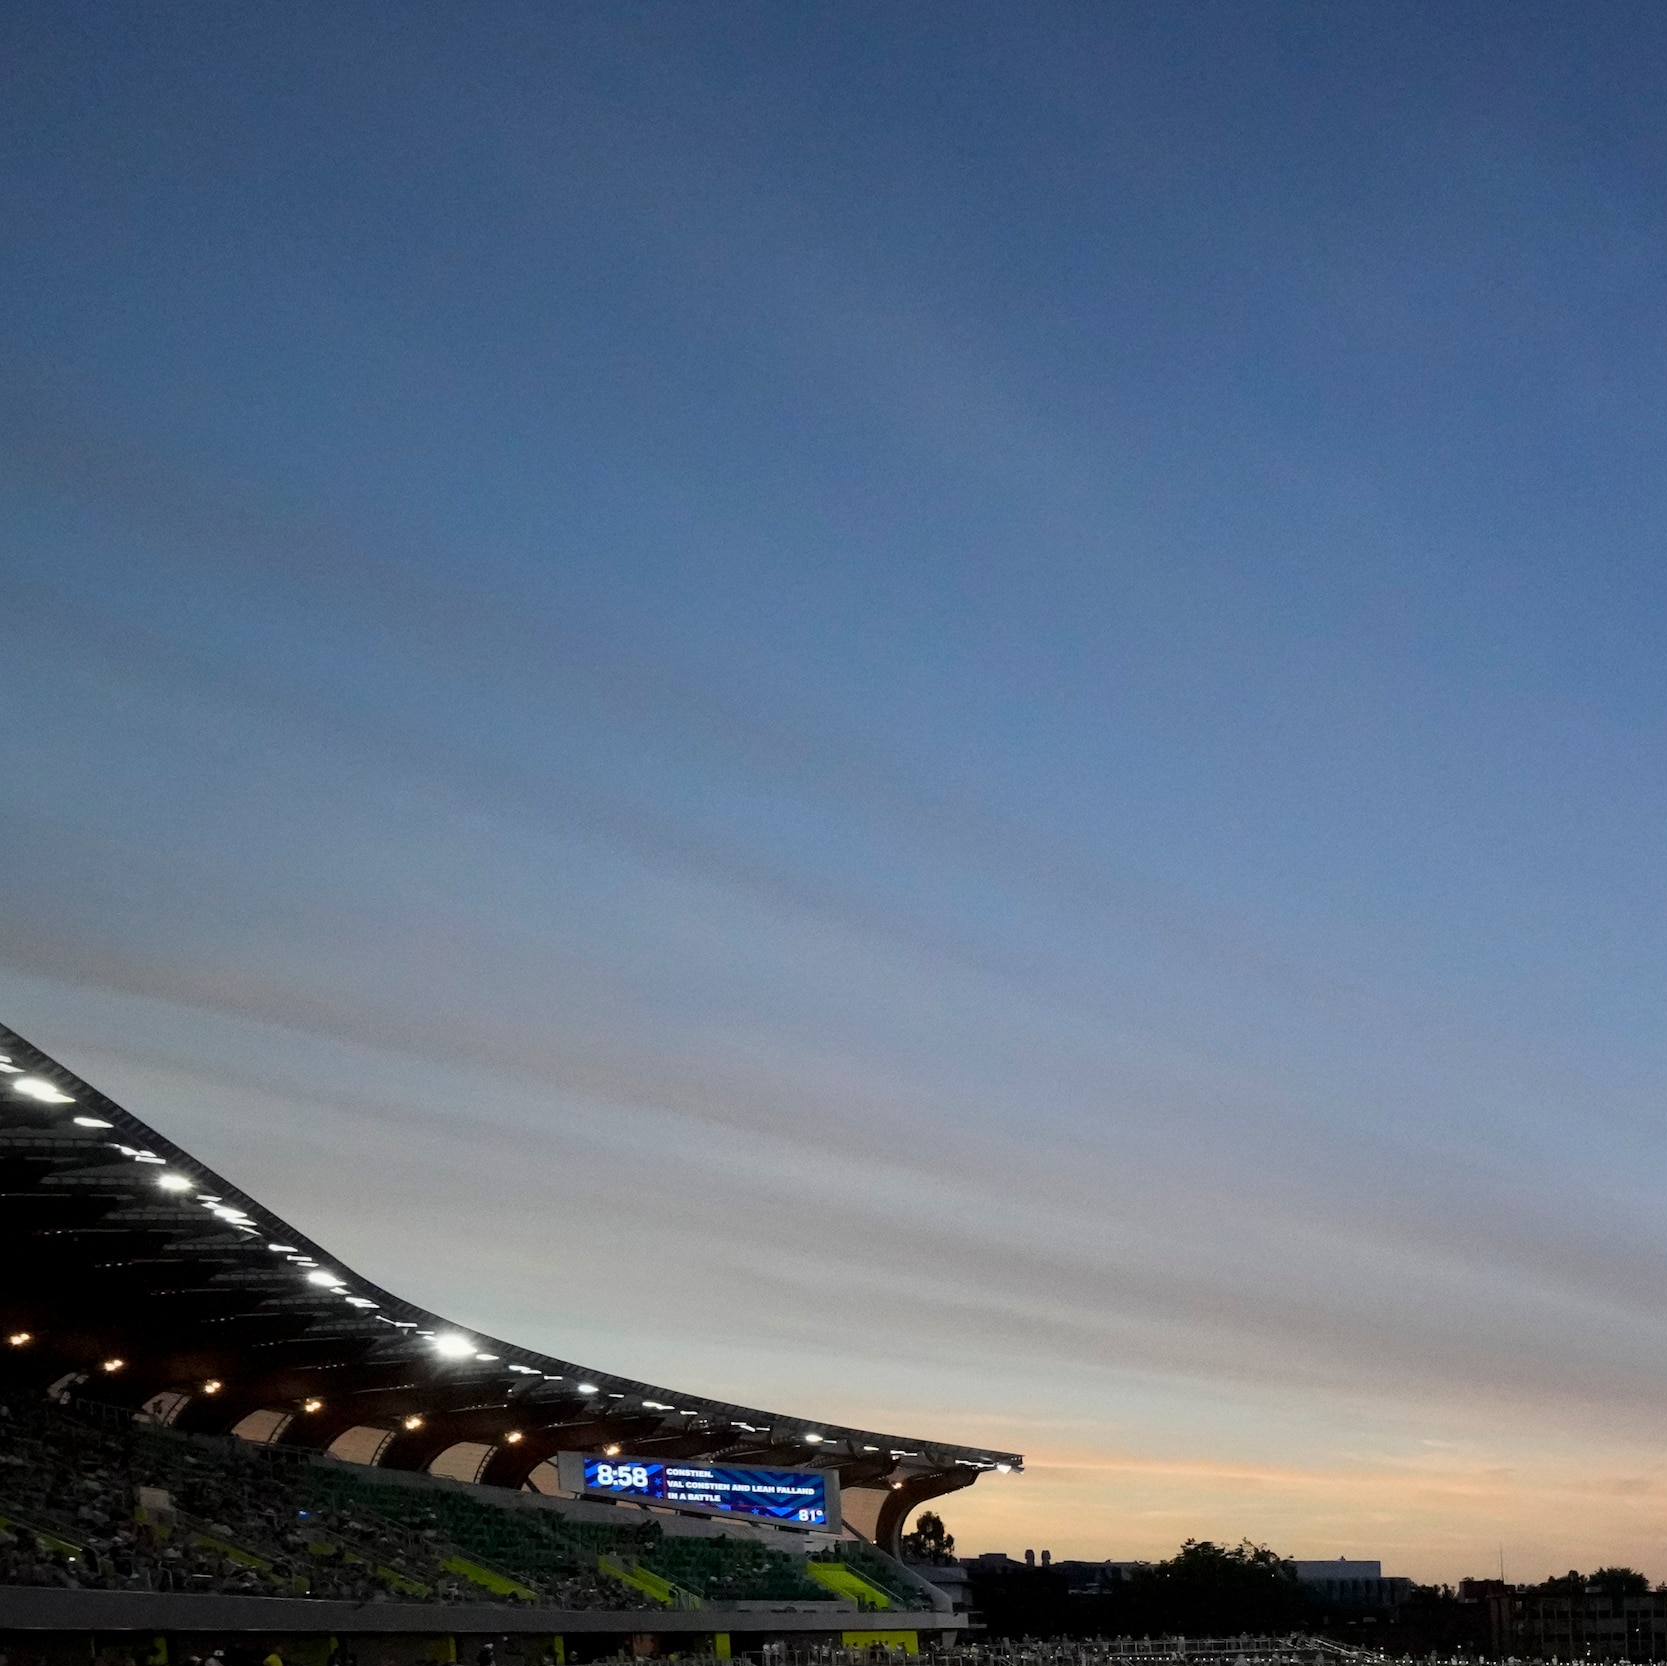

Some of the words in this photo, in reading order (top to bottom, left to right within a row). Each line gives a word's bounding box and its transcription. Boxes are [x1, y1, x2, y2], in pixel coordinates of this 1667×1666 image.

[597, 1464, 648, 1487] 8:58
[667, 1480, 684, 1488] VAL
[685, 1481, 730, 1491] CONSTIEN
[732, 1484, 750, 1492] AND
[752, 1485, 775, 1493] LEAH
[776, 1486, 815, 1495] FALLAND
[667, 1492, 678, 1500] IN
[688, 1493, 721, 1502] BATTLE
[798, 1509, 823, 1521] 81°
